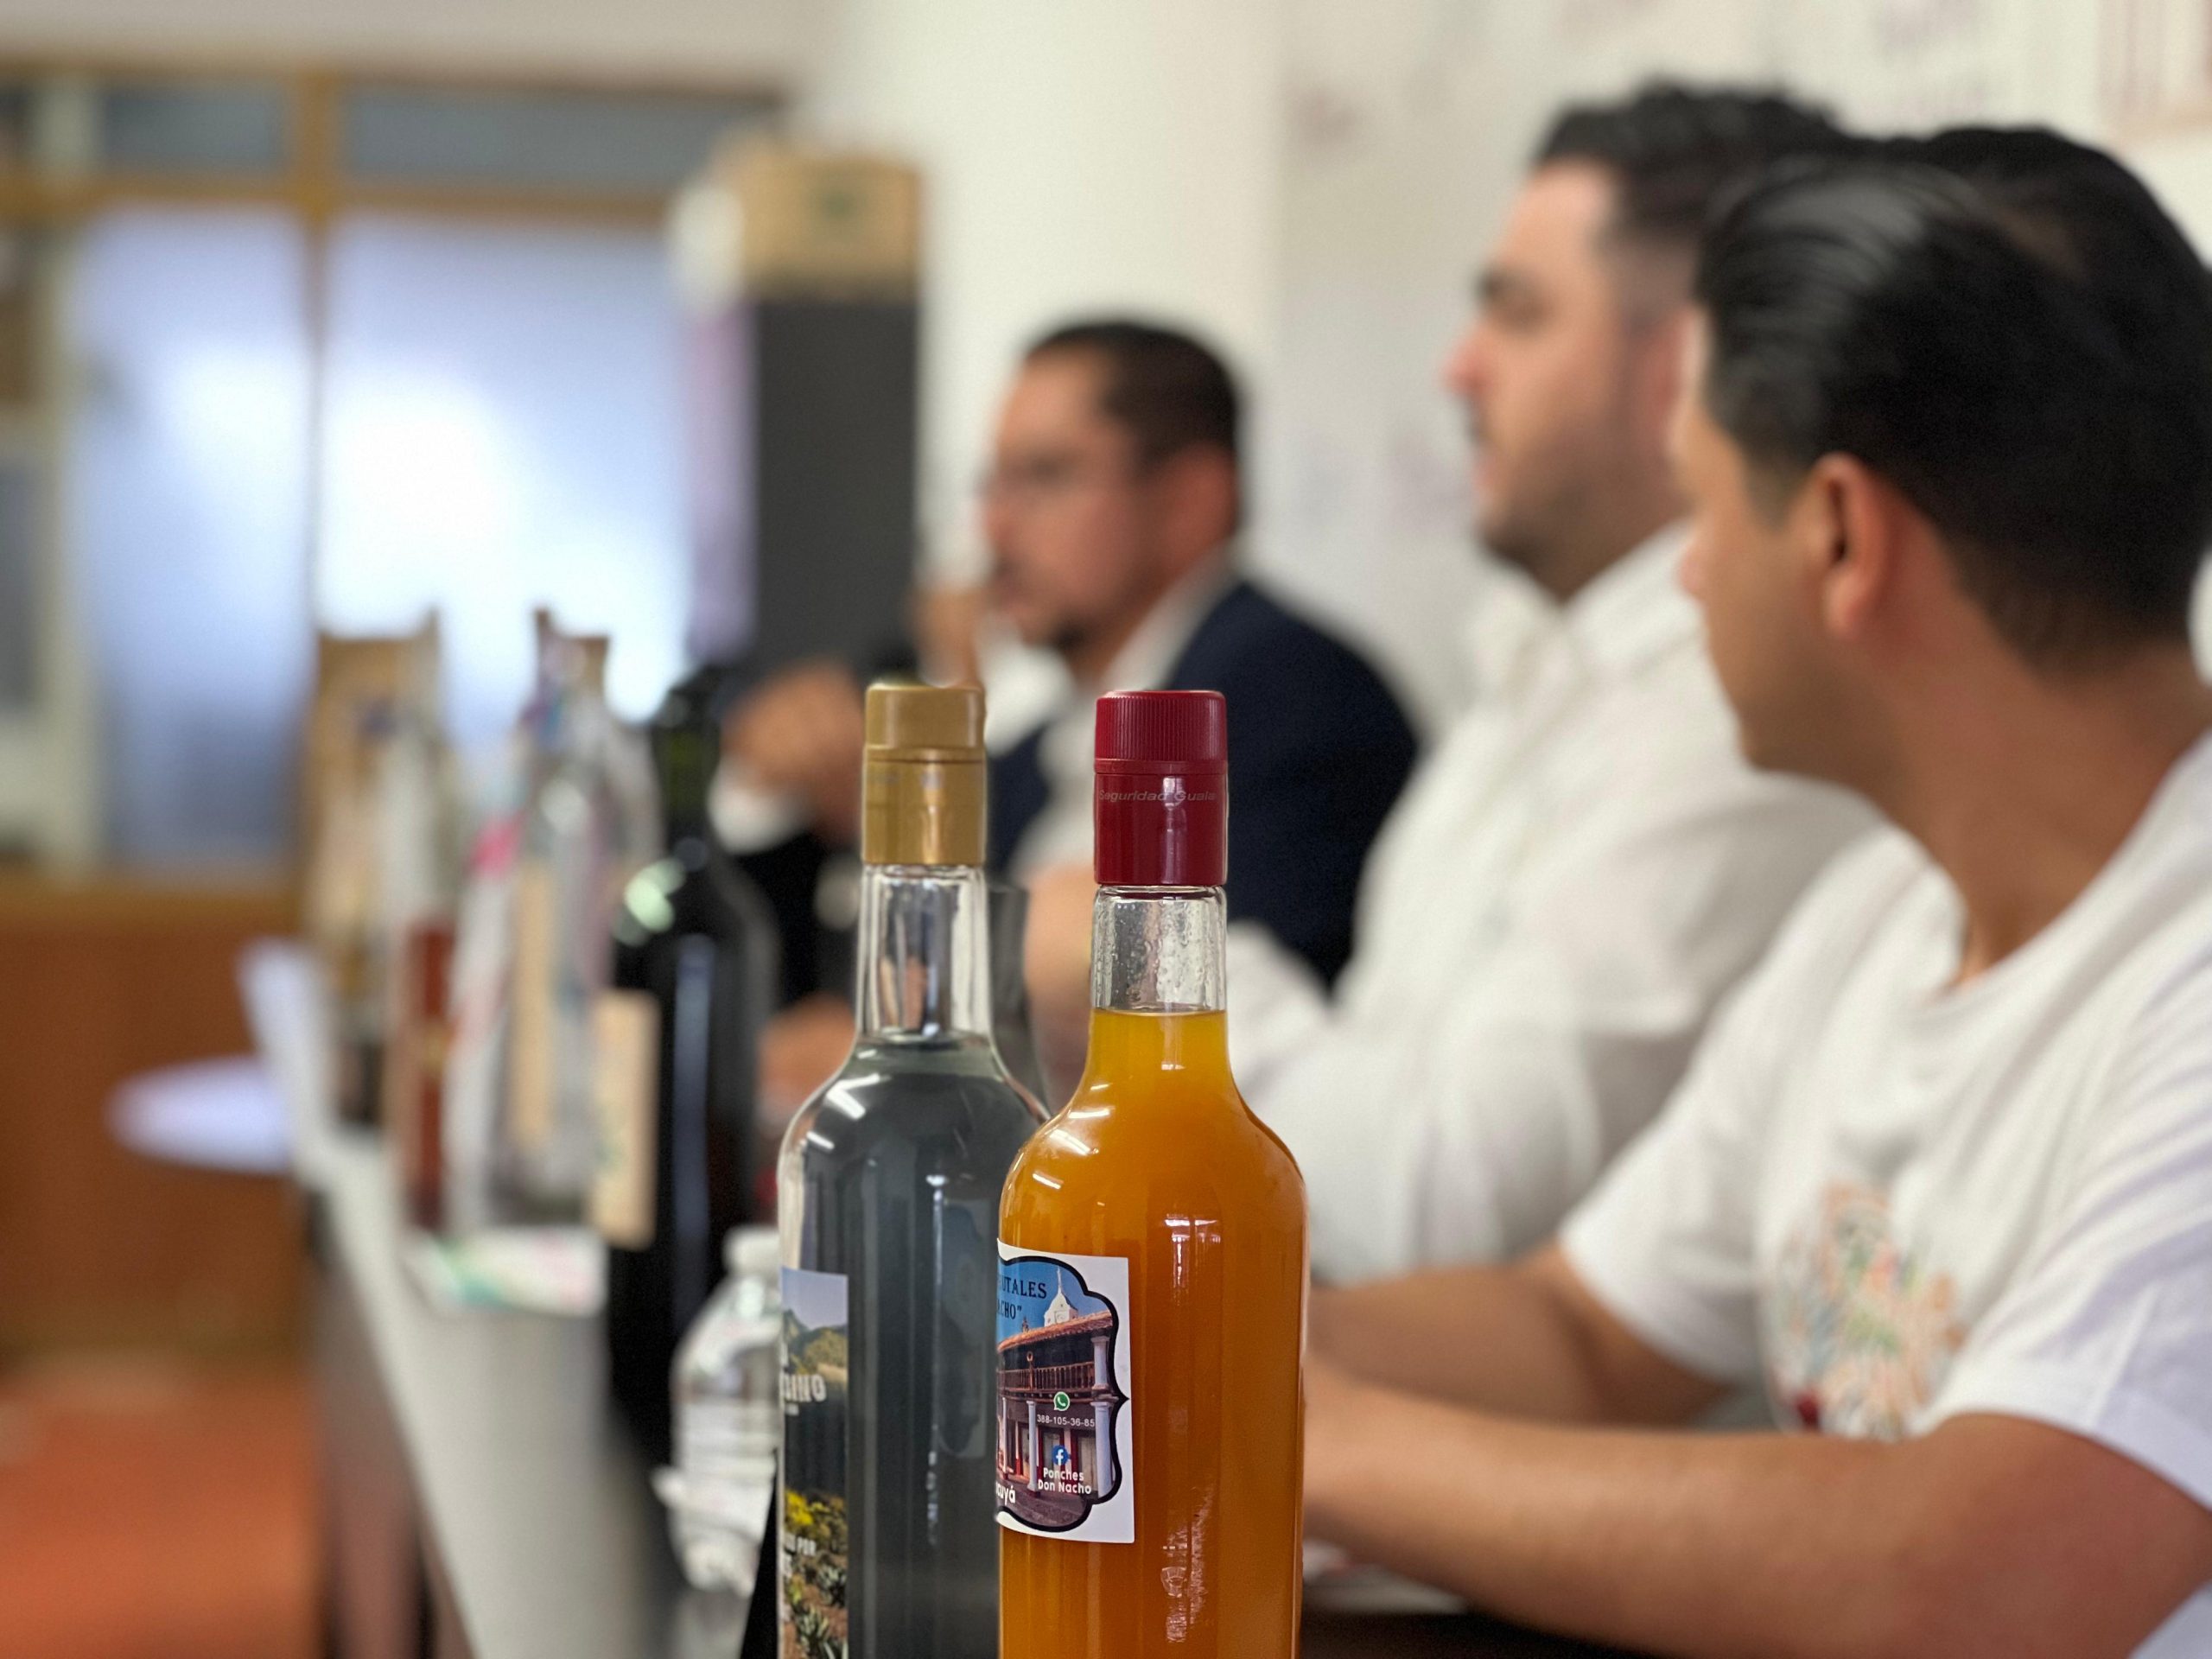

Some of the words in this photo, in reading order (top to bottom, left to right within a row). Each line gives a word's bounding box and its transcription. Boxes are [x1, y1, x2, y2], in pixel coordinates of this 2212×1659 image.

[1000, 1274, 1047, 1300] UTALES
[1043, 1467, 1085, 1482] Ponches
[1038, 1478, 1056, 1492] Don
[1058, 1481, 1092, 1495] Nacho
